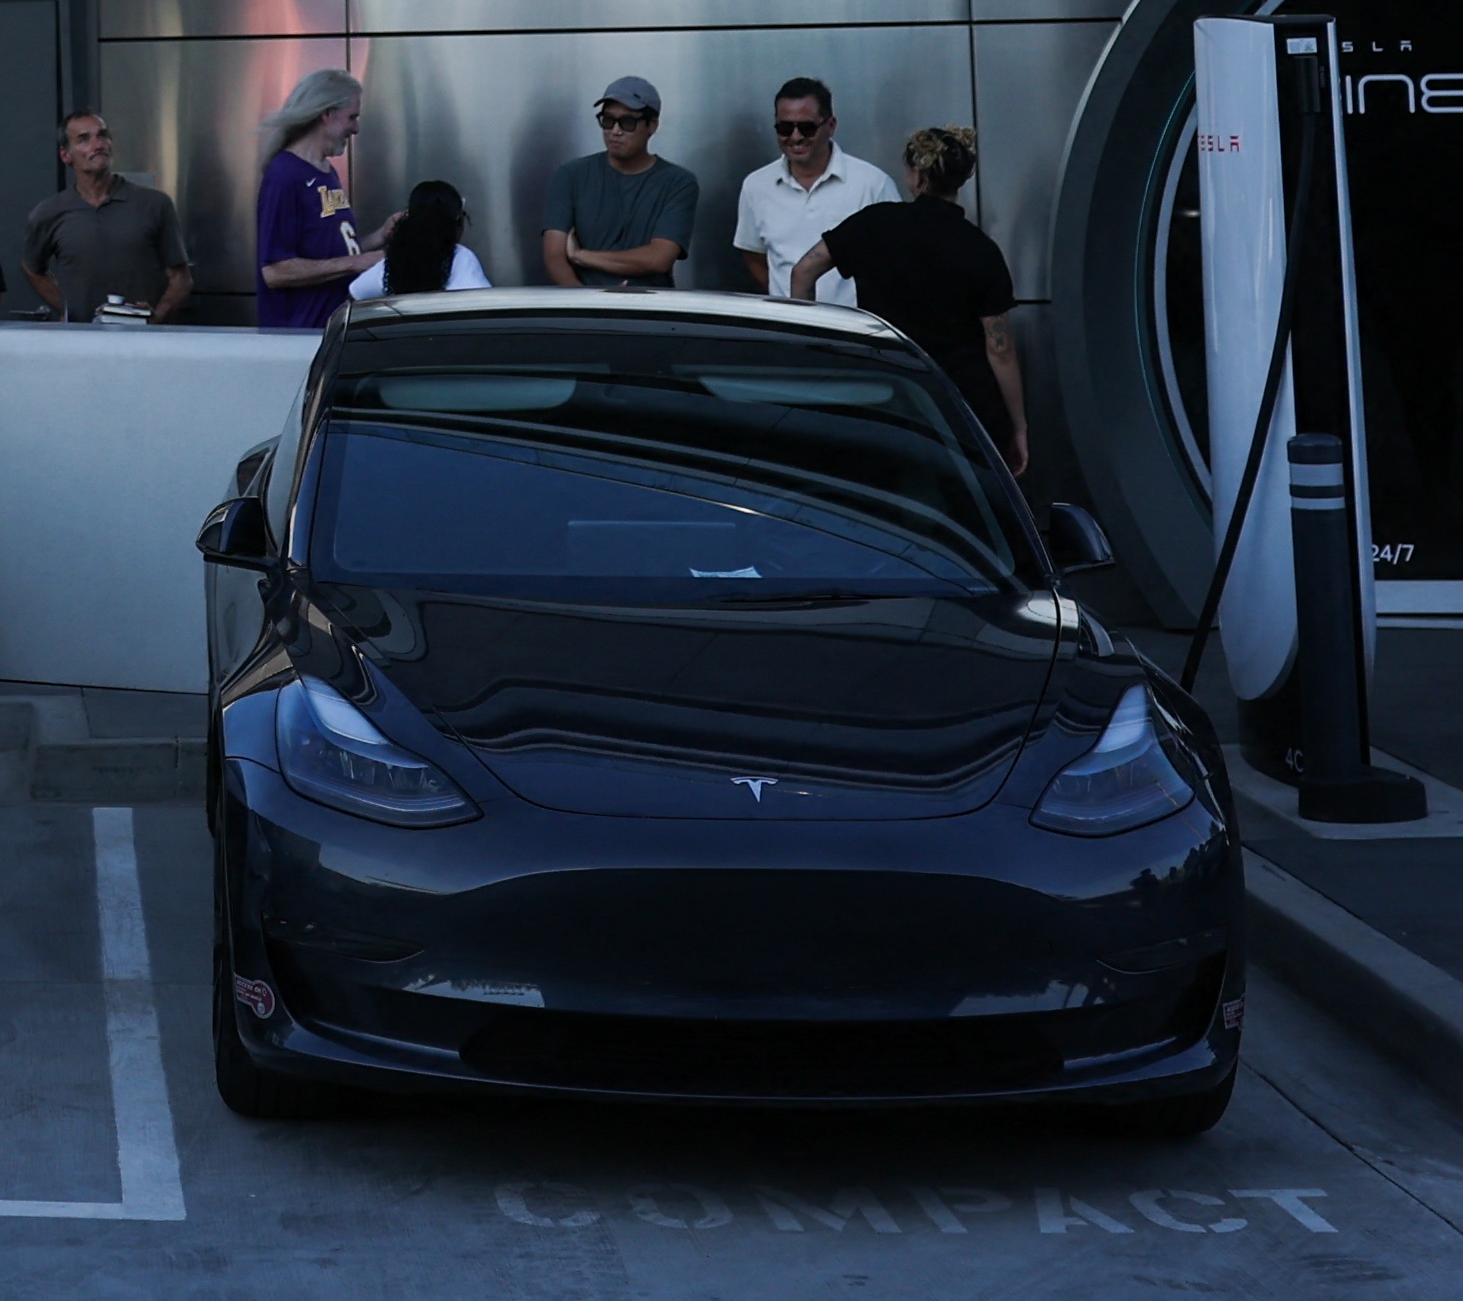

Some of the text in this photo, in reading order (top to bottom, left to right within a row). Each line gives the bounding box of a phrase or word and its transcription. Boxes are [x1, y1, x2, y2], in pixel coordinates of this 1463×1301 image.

[1341, 39, 1412, 53] SLA
[1201, 135, 1240, 153] ESLA
[1372, 543, 1414, 565] 24/7
[494, 1181, 1340, 1235] COMPACT
